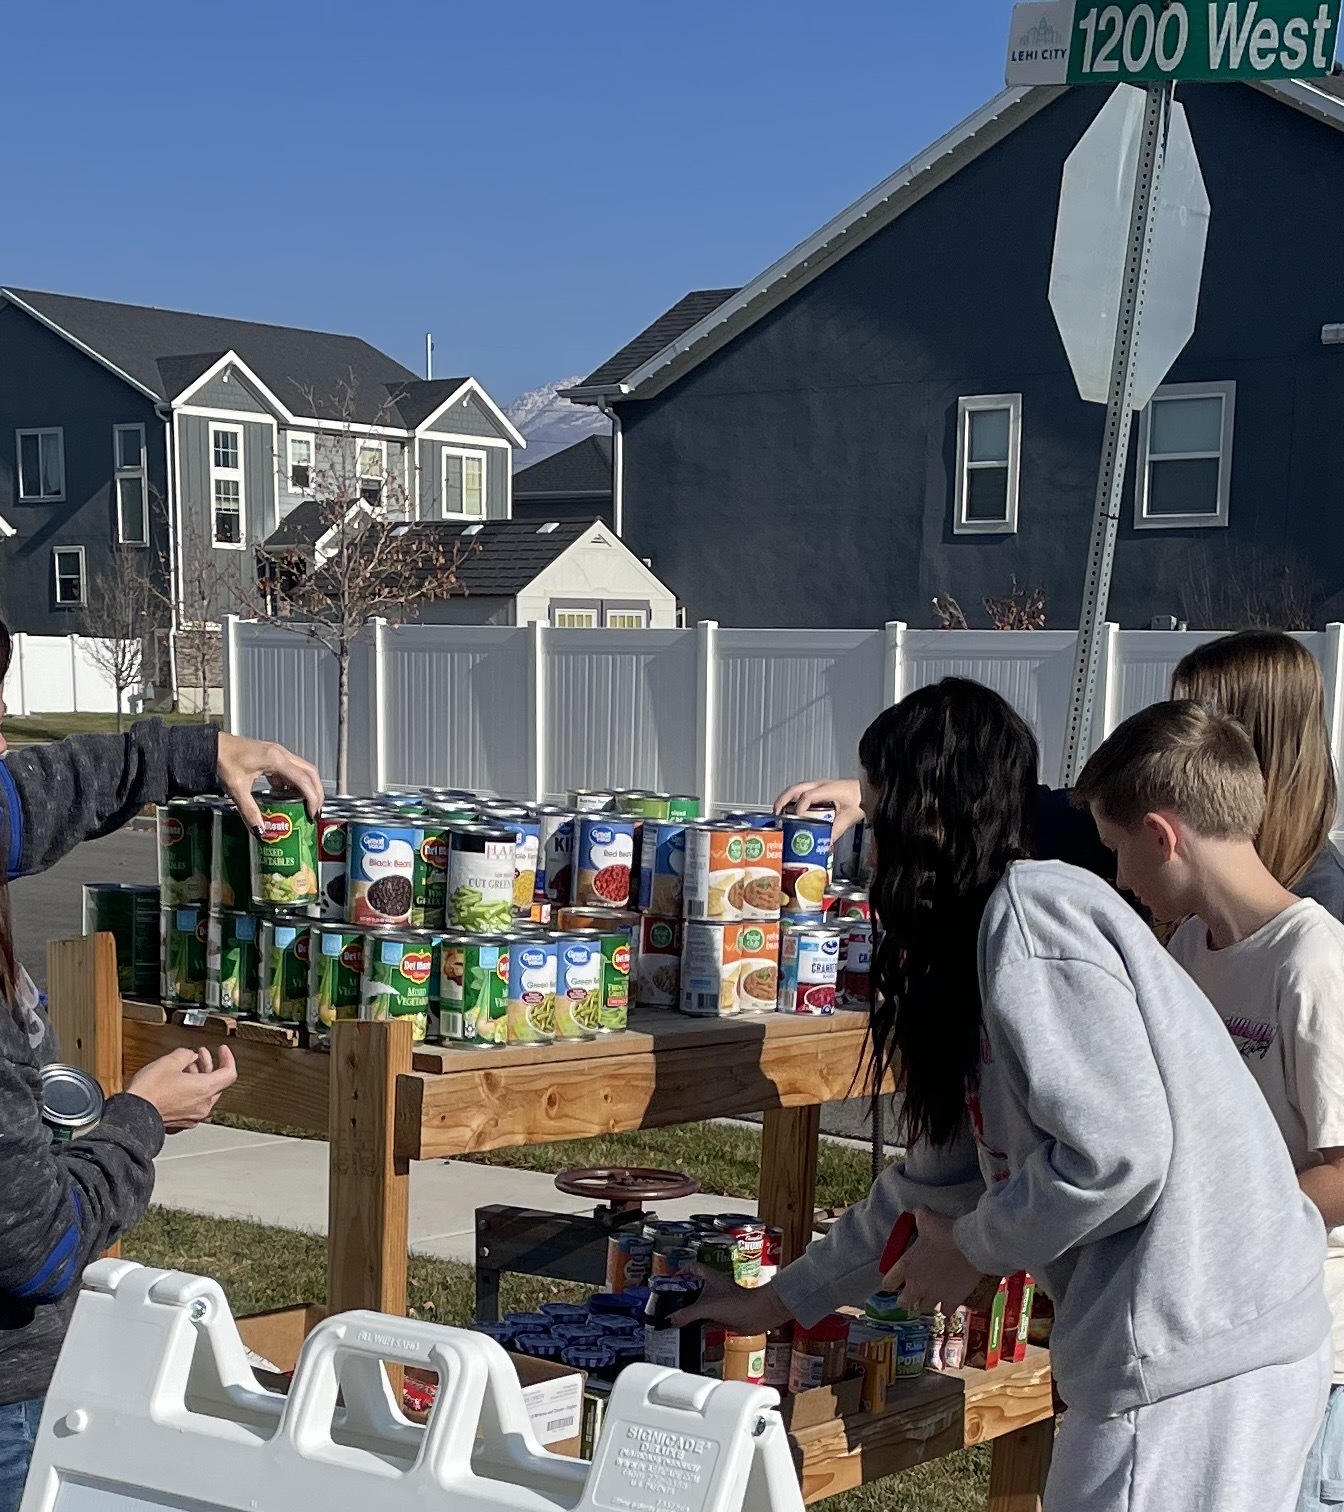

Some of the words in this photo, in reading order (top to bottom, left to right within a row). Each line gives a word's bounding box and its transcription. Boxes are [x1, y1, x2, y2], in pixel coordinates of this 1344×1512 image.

[1079, 2, 1188, 73] 1200
[1208, 1, 1332, 71] West
[1011, 49, 1040, 62] LEHI
[1041, 48, 1068, 61] CITY
[369, 858, 391, 868] Black
[468, 878, 487, 889] CUT
[404, 960, 416, 971] Del
[395, 1338, 420, 1351] SAND
